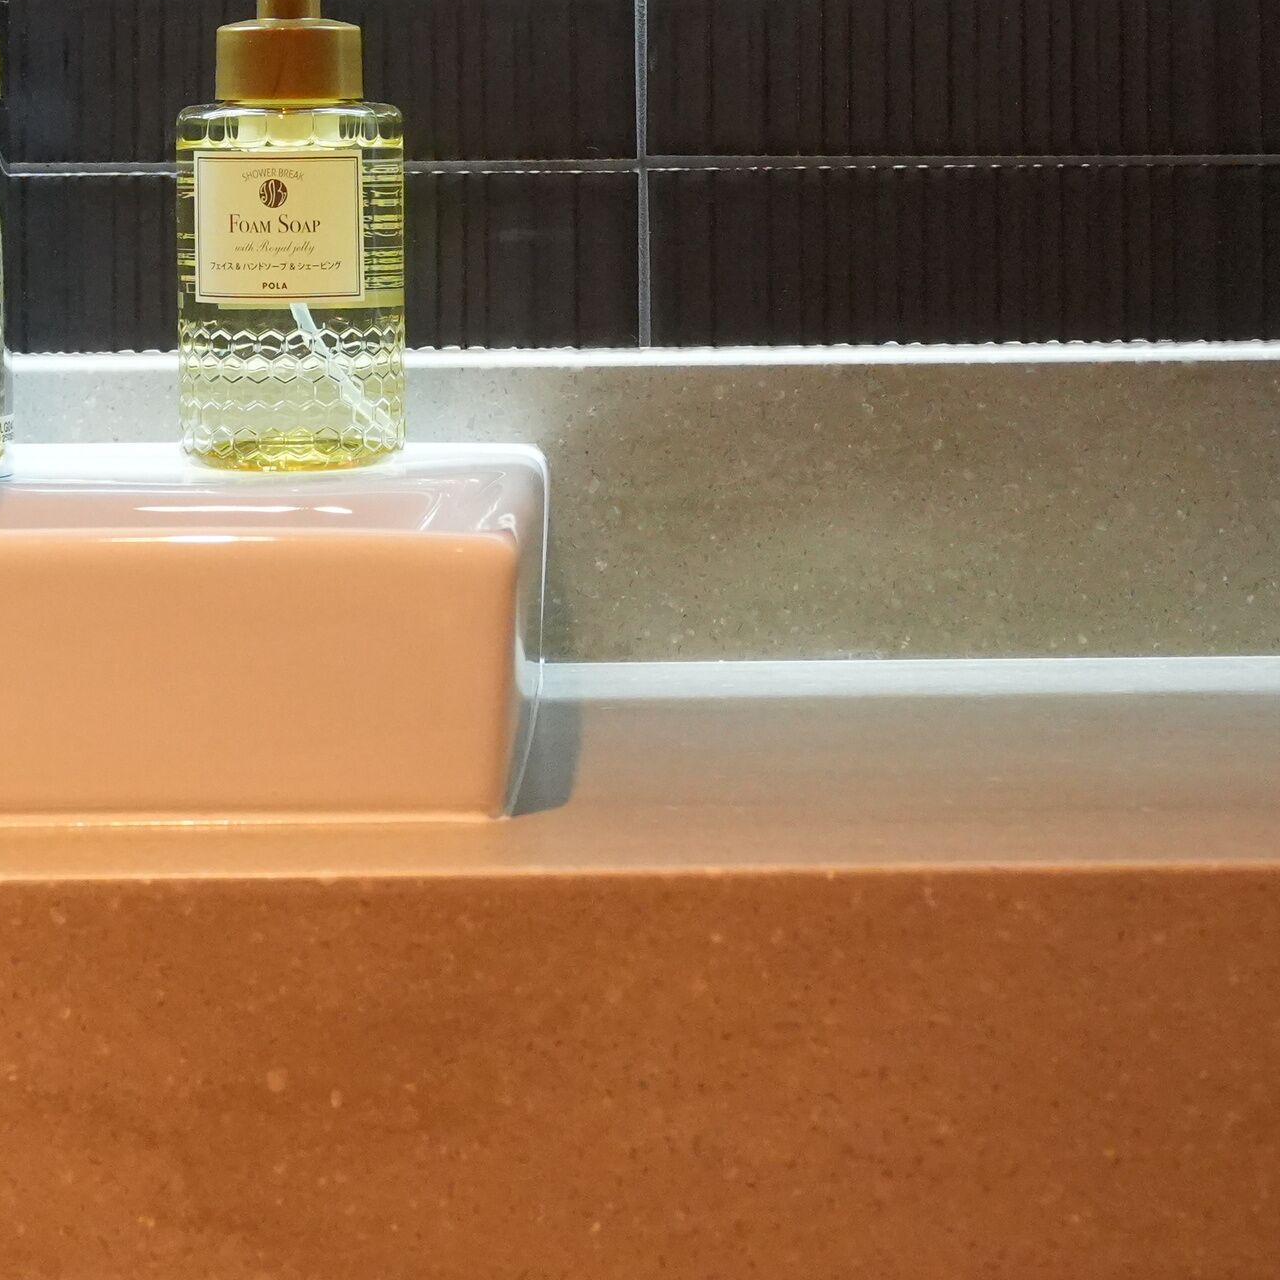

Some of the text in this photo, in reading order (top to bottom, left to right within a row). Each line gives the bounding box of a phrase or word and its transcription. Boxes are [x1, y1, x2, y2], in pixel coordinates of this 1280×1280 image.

[241, 167, 305, 181] SHOWER BREAK
[234, 240, 316, 256] with Royal jelly
[262, 282, 288, 290] POLA
